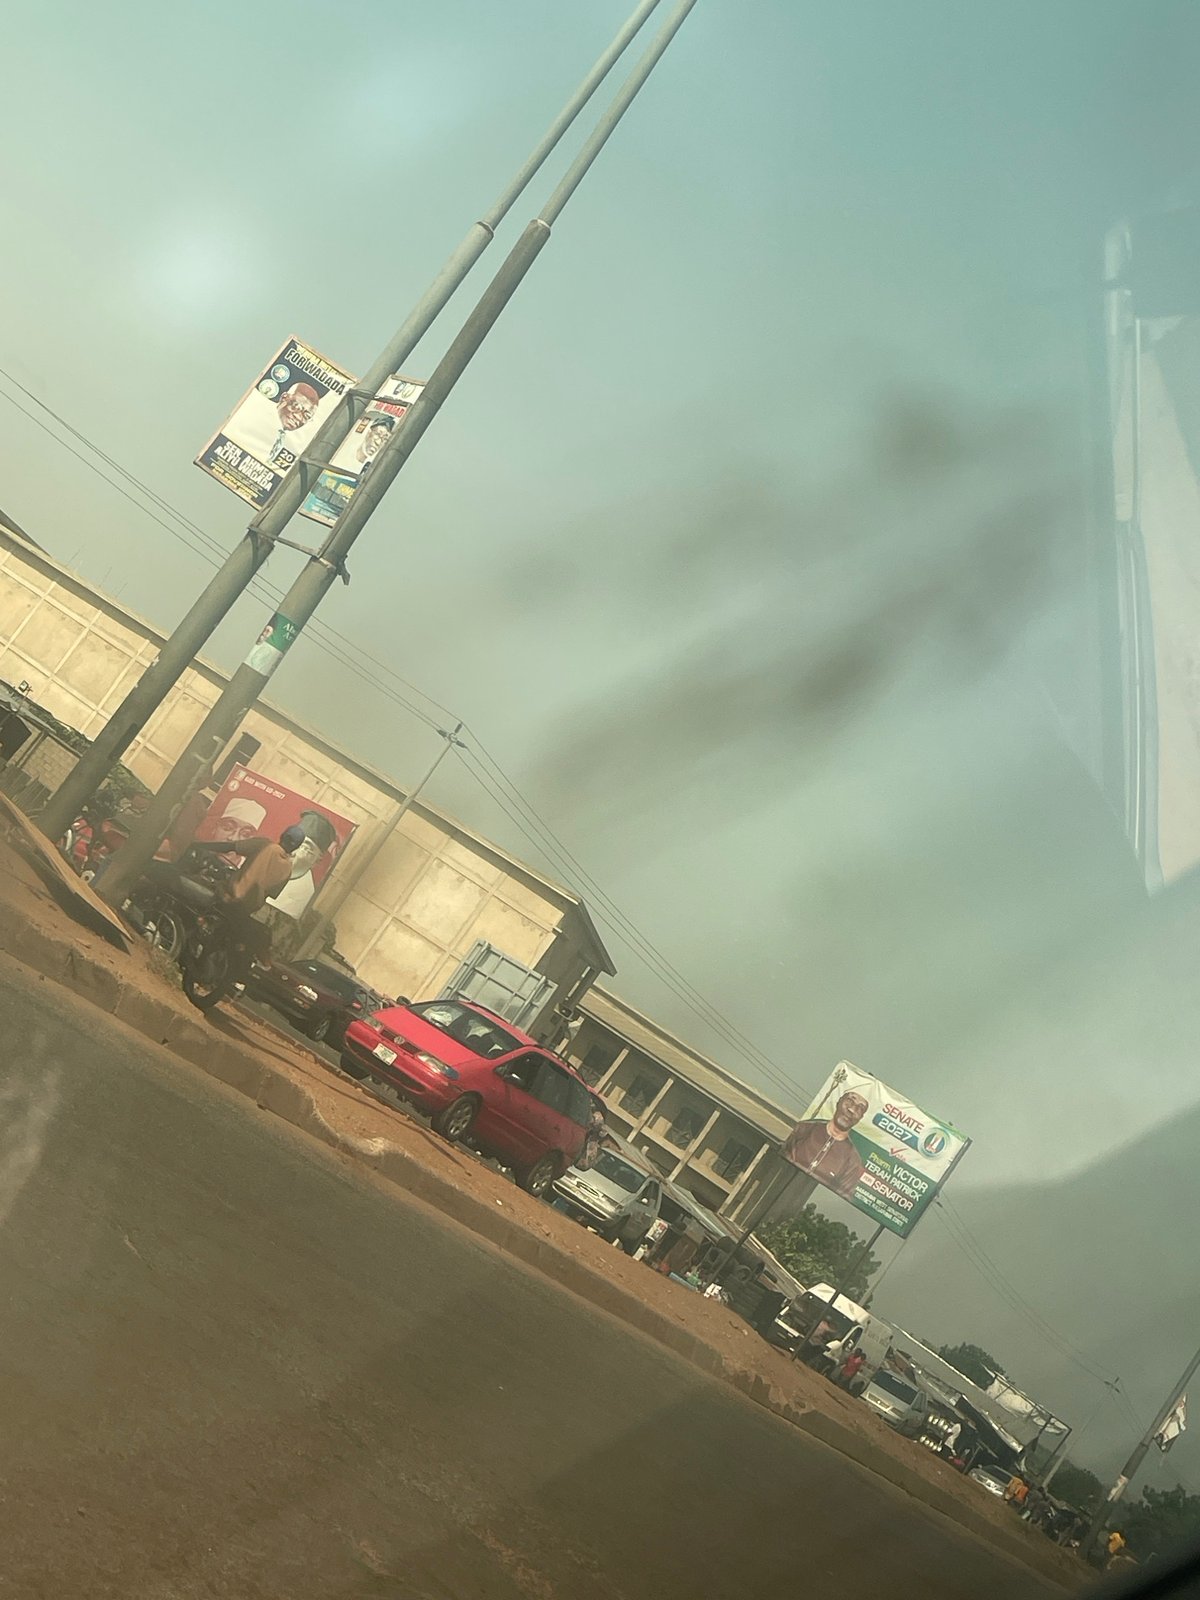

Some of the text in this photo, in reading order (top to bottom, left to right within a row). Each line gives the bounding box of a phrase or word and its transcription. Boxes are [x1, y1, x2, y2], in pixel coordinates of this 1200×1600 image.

[286, 349, 307, 368] FOR
[304, 361, 346, 395] WADADA
[214, 444, 241, 467] ALIYU
[238, 462, 273, 491] WADADA
[243, 455, 275, 481] AHMED
[277, 457, 289, 469] 27
[280, 450, 294, 462] 20
[877, 1117, 912, 1143] 2027
[882, 1103, 924, 1134] SENATE
[864, 1160, 922, 1201] TERAH PATRICK
[893, 1164, 929, 1193] VICTOR
[872, 1180, 914, 1211] SENATOR
